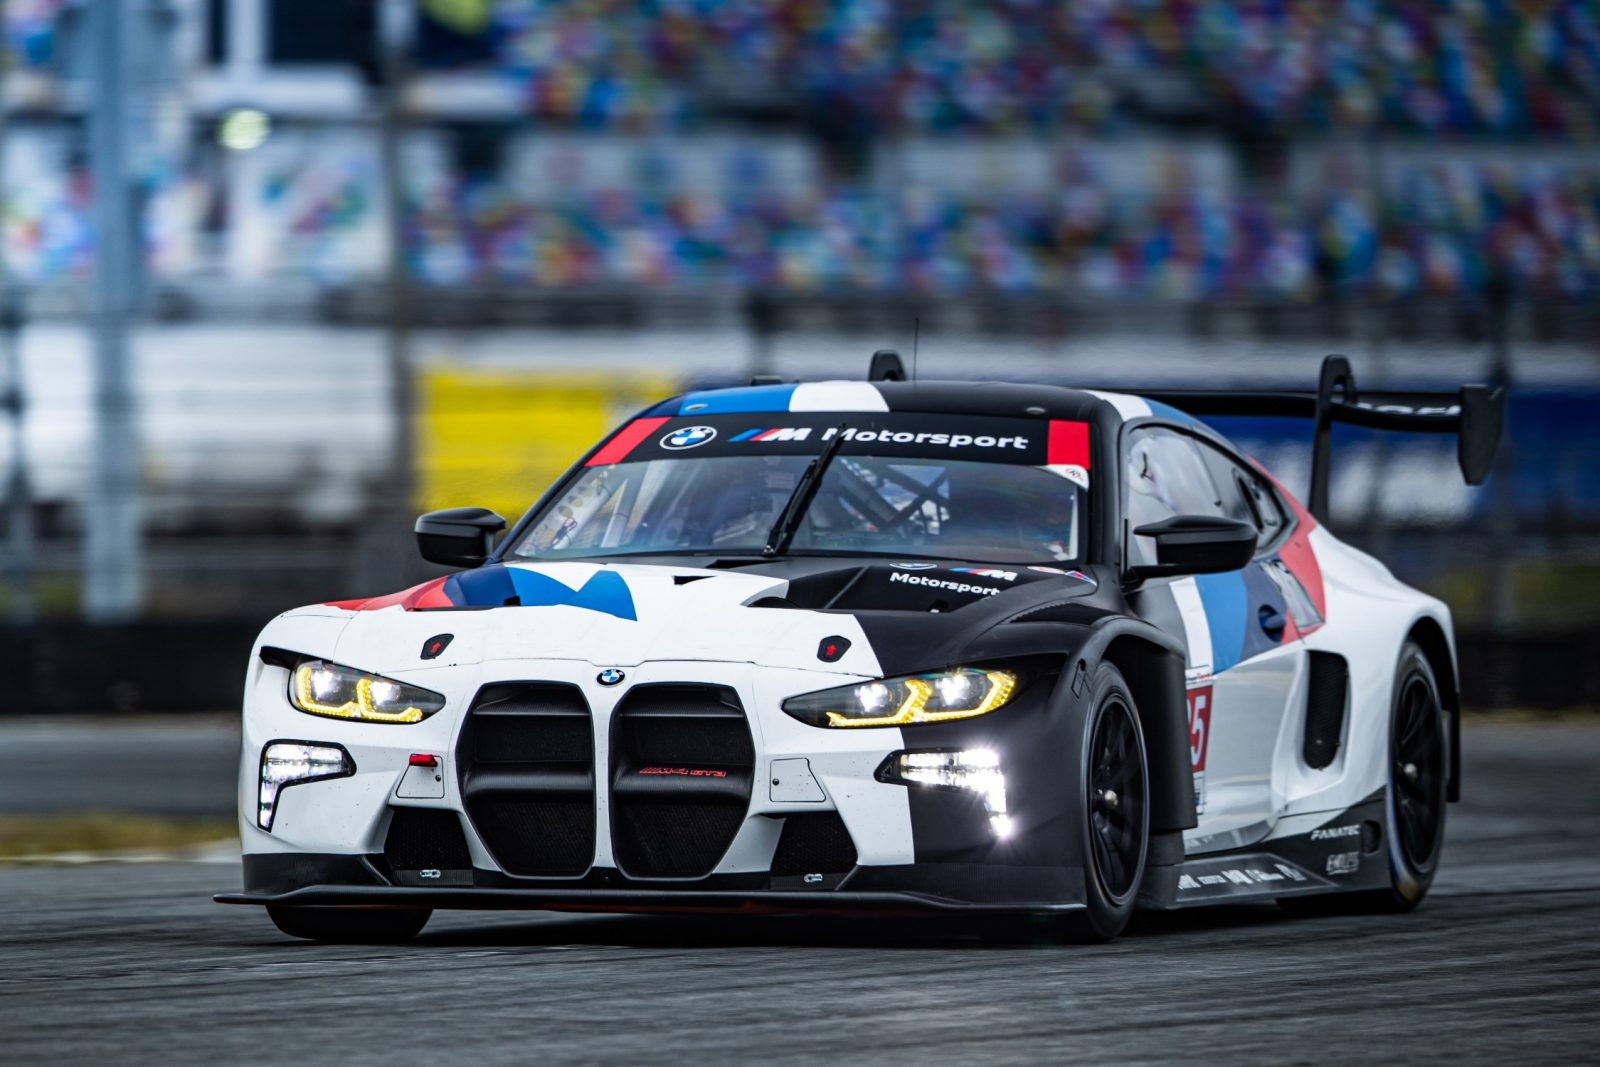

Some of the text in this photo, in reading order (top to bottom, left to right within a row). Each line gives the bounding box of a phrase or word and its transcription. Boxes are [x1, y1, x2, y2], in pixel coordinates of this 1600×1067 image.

[821, 427, 1029, 449] Motorsport
[889, 572, 1001, 596] Motorsport
[1187, 695, 1207, 766] 5
